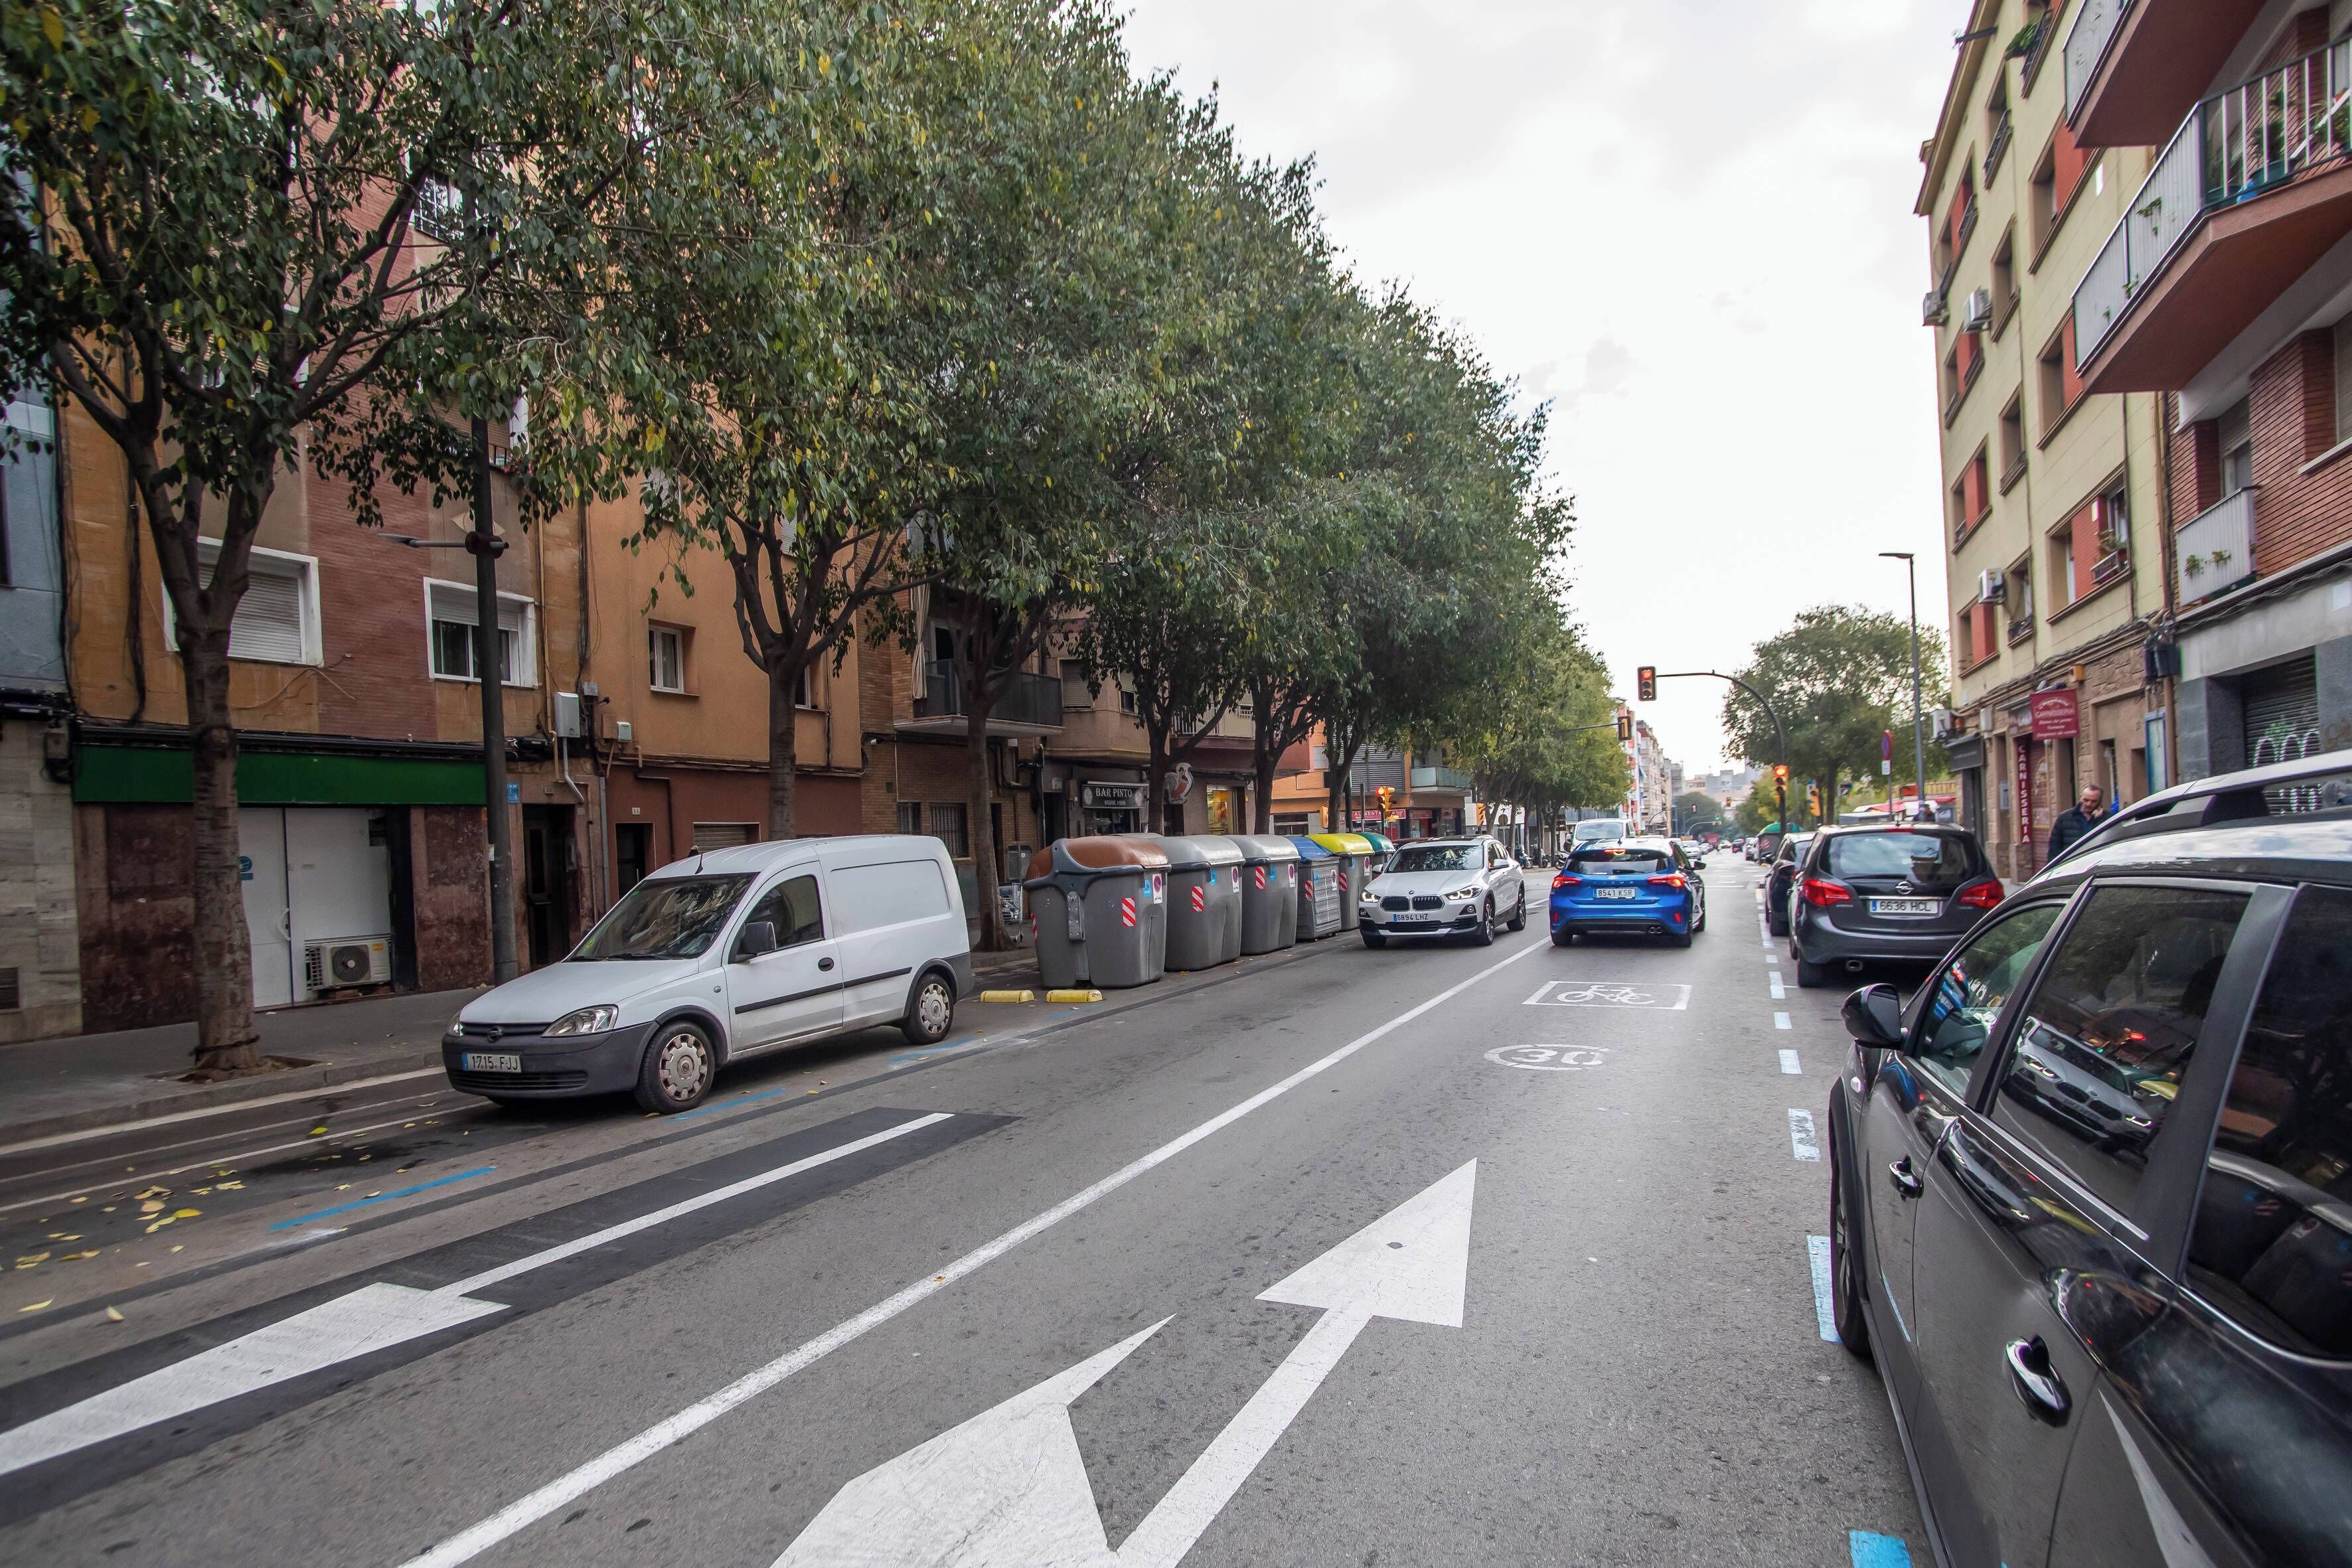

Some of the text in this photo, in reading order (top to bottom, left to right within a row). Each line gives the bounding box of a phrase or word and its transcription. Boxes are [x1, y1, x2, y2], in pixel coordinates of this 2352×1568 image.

[1095, 787, 1133, 797] BAR PINTO
[2018, 745, 2030, 843] CARNISSERIA
[1879, 901, 1931, 911] 6636 HCL
[471, 1055, 518, 1070] 1715 FJJ
[1511, 1048, 1605, 1065] 30
